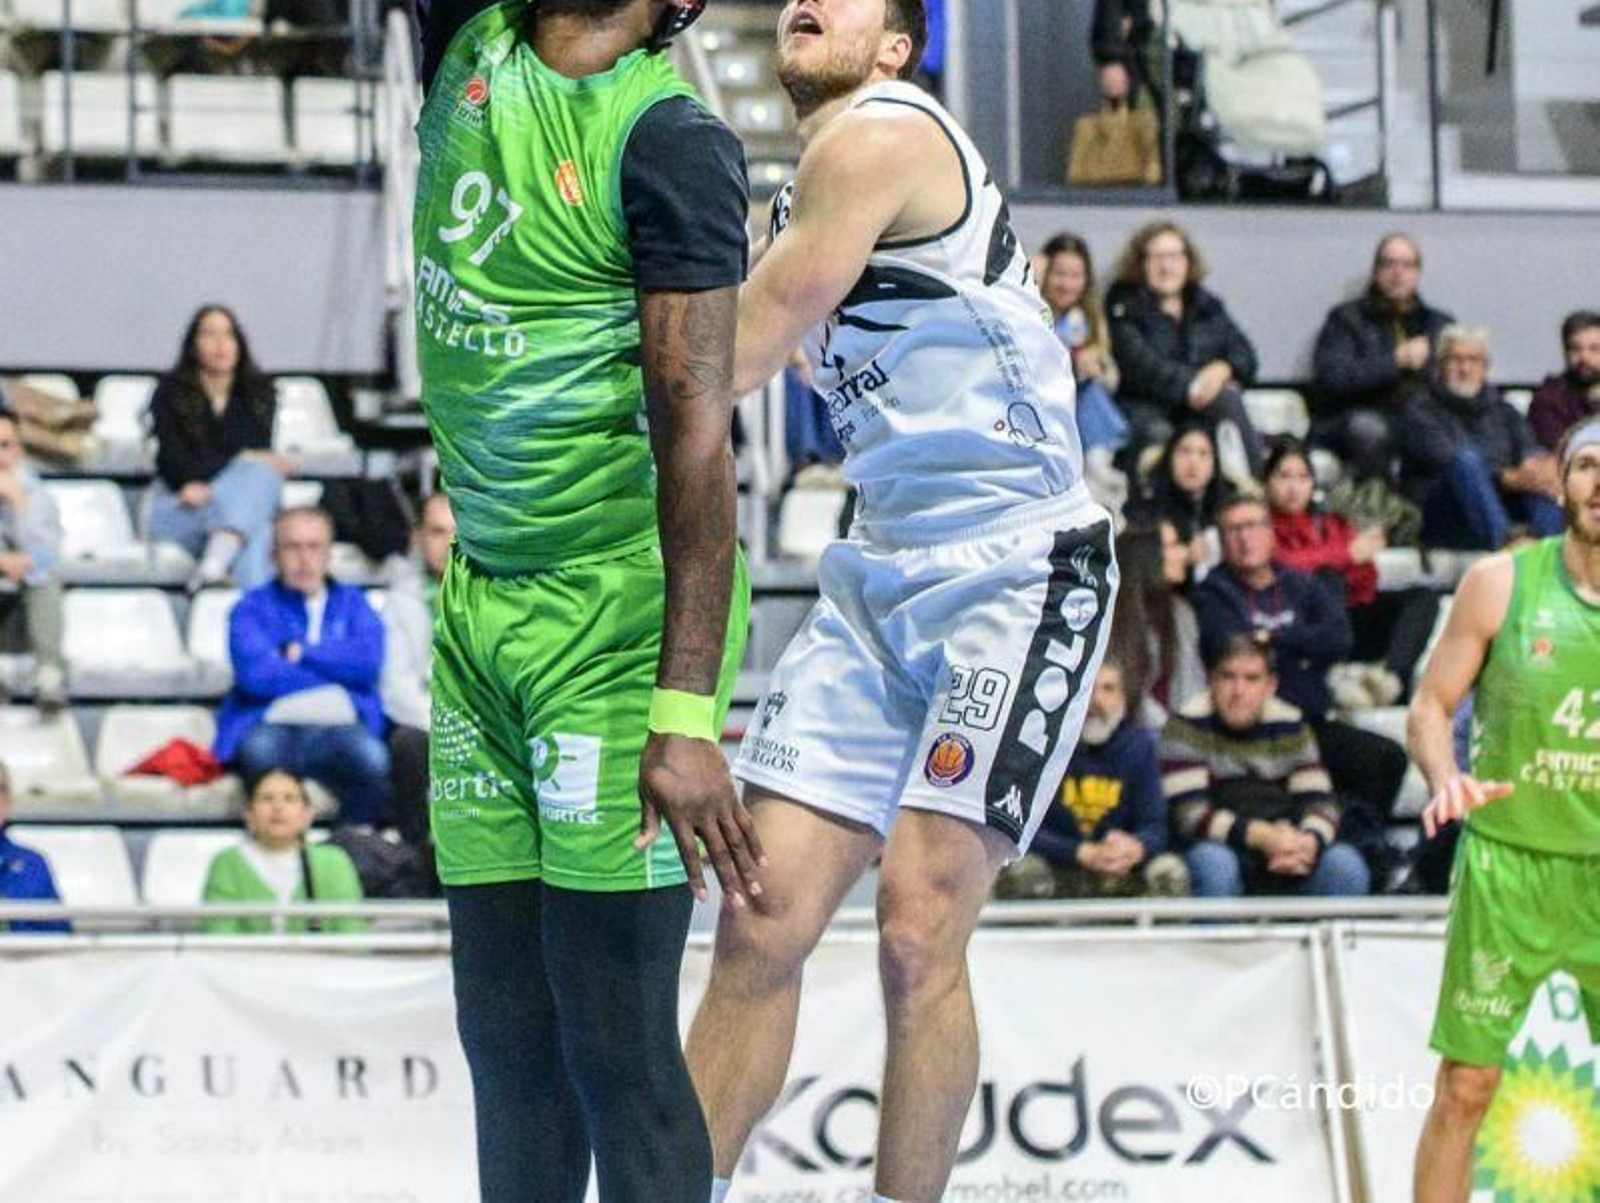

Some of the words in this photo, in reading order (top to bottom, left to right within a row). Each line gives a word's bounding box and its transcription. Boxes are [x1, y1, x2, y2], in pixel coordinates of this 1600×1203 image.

[438, 171, 523, 267] 97
[828, 359, 890, 414] arral
[938, 666, 1011, 732] 29
[1018, 587, 1099, 756] POLO
[1536, 749, 1600, 774] AMIC
[0, 1054, 439, 1100] ANGUARD
